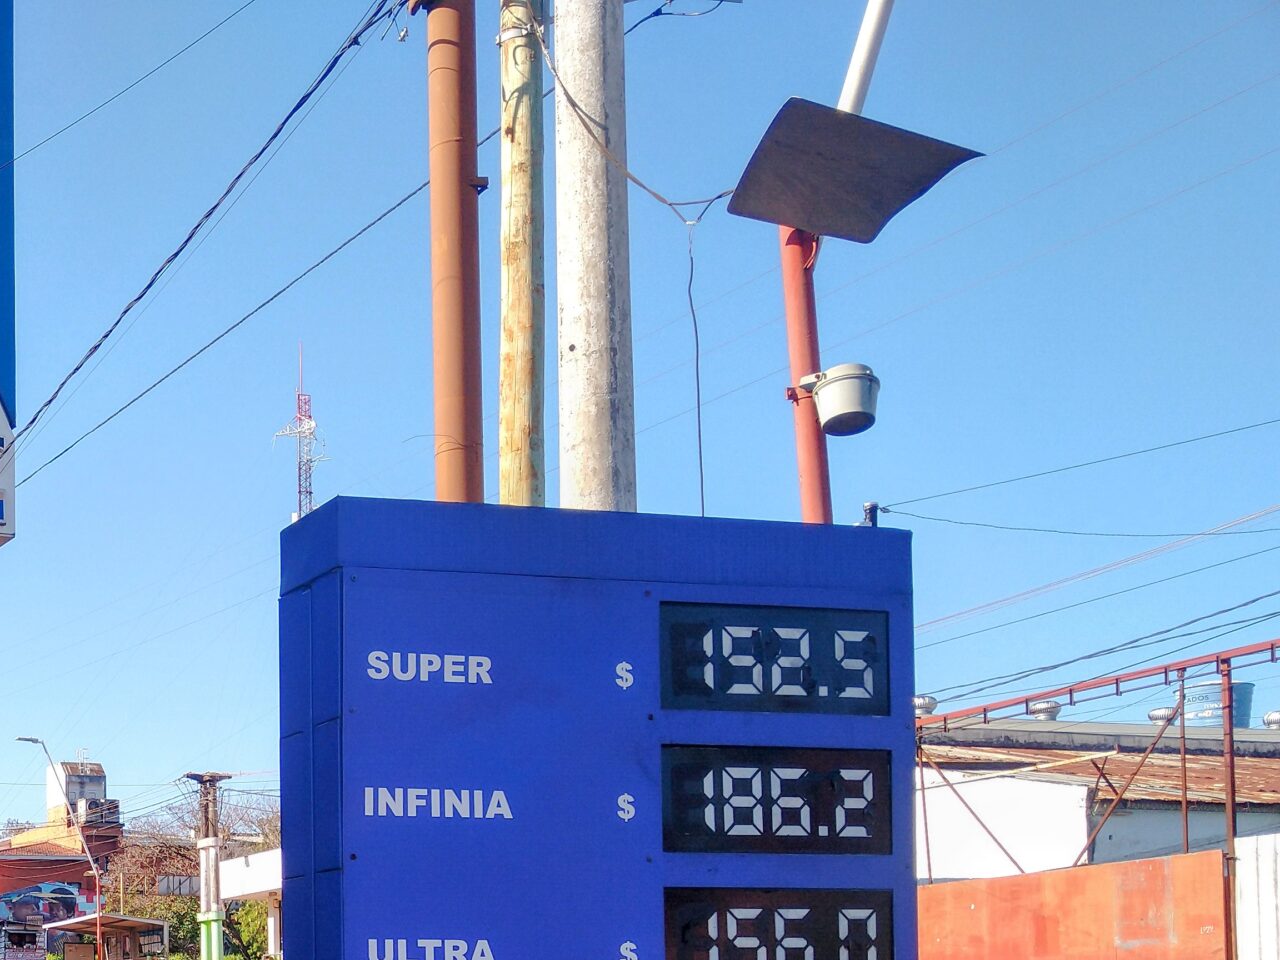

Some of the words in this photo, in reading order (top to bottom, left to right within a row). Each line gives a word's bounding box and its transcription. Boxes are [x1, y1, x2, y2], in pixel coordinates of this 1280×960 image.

[367, 651, 493, 684] SUPER
[615, 662, 634, 689] $
[703, 626, 873, 698] 152.5
[364, 787, 513, 819] INFINIA
[617, 793, 636, 821] $
[703, 768, 873, 837] 186.2
